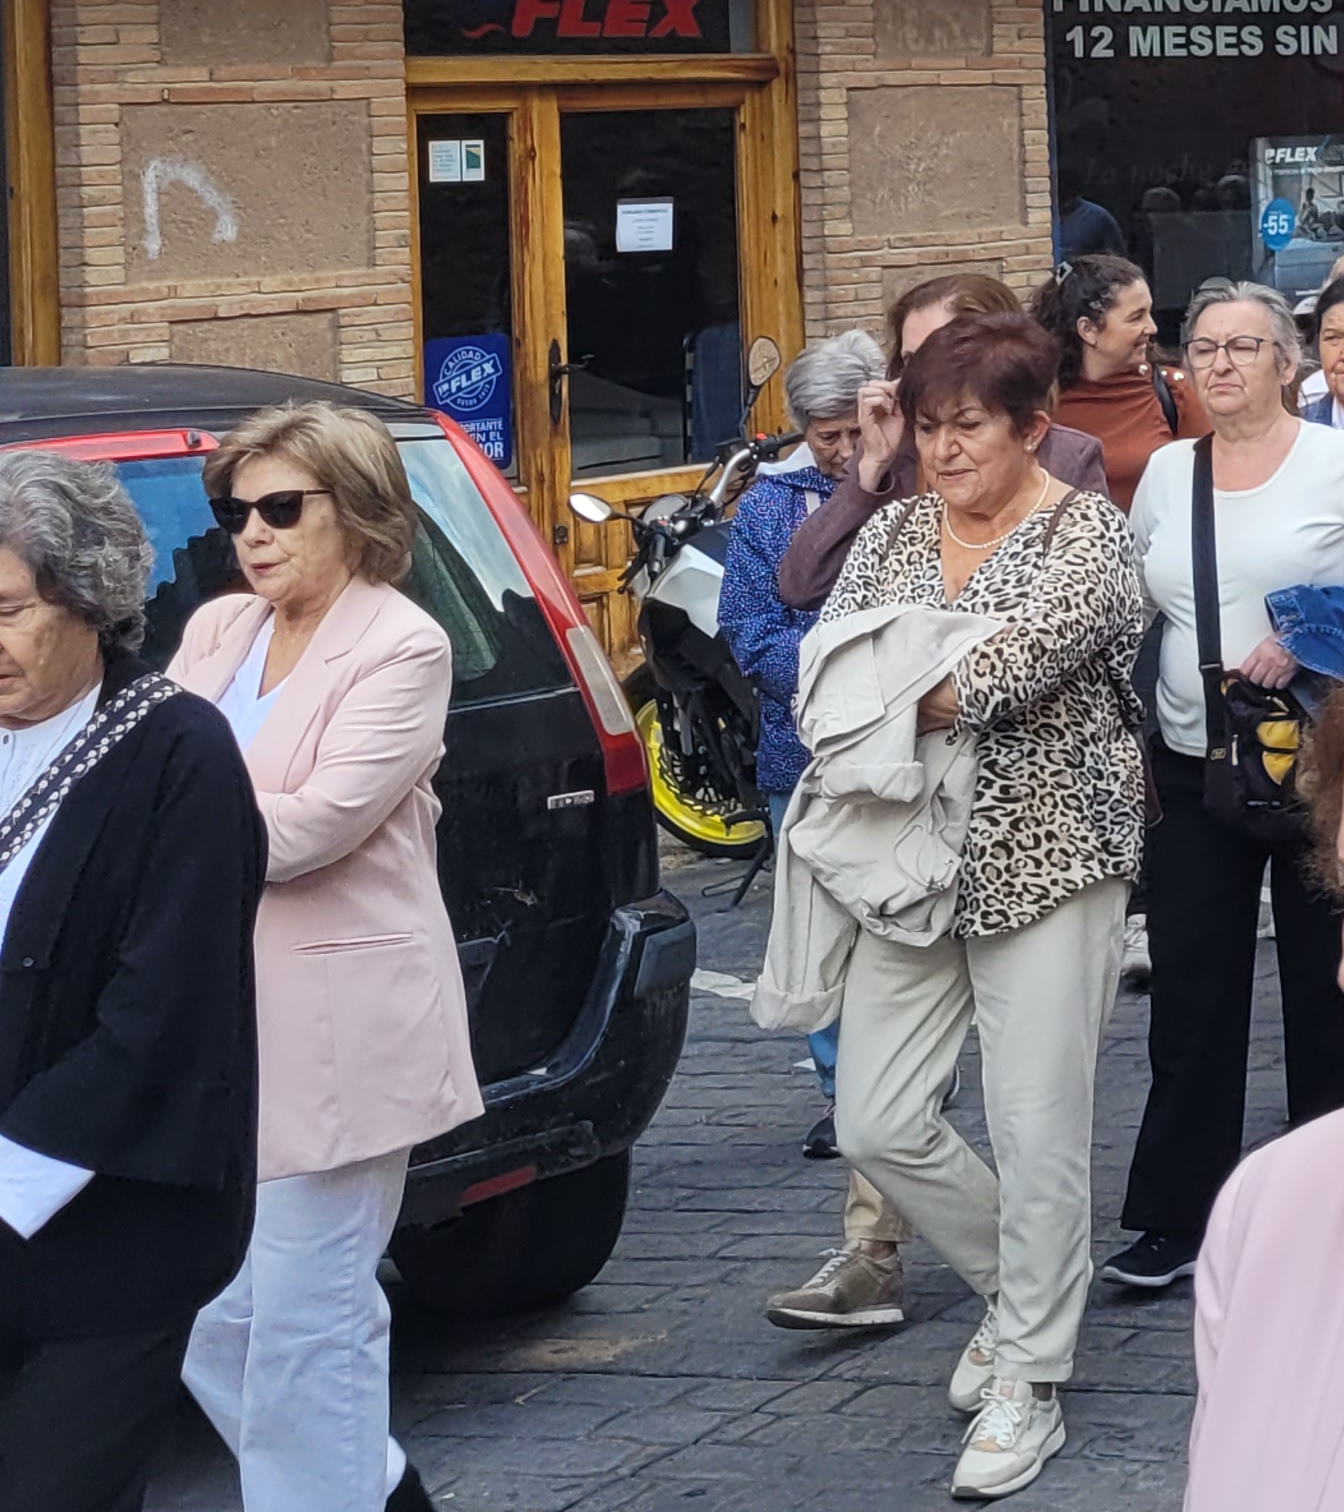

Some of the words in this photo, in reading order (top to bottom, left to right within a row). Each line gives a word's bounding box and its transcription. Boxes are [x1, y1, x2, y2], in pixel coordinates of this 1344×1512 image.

[1065, 24, 1115, 59] 12
[1129, 23, 1264, 58] MESES
[1275, 23, 1338, 56] SIN
[1275, 147, 1318, 164] FLEX
[444, 350, 481, 376] CALIDAD
[450, 359, 496, 393] FLEX
[489, 431, 504, 442] EL
